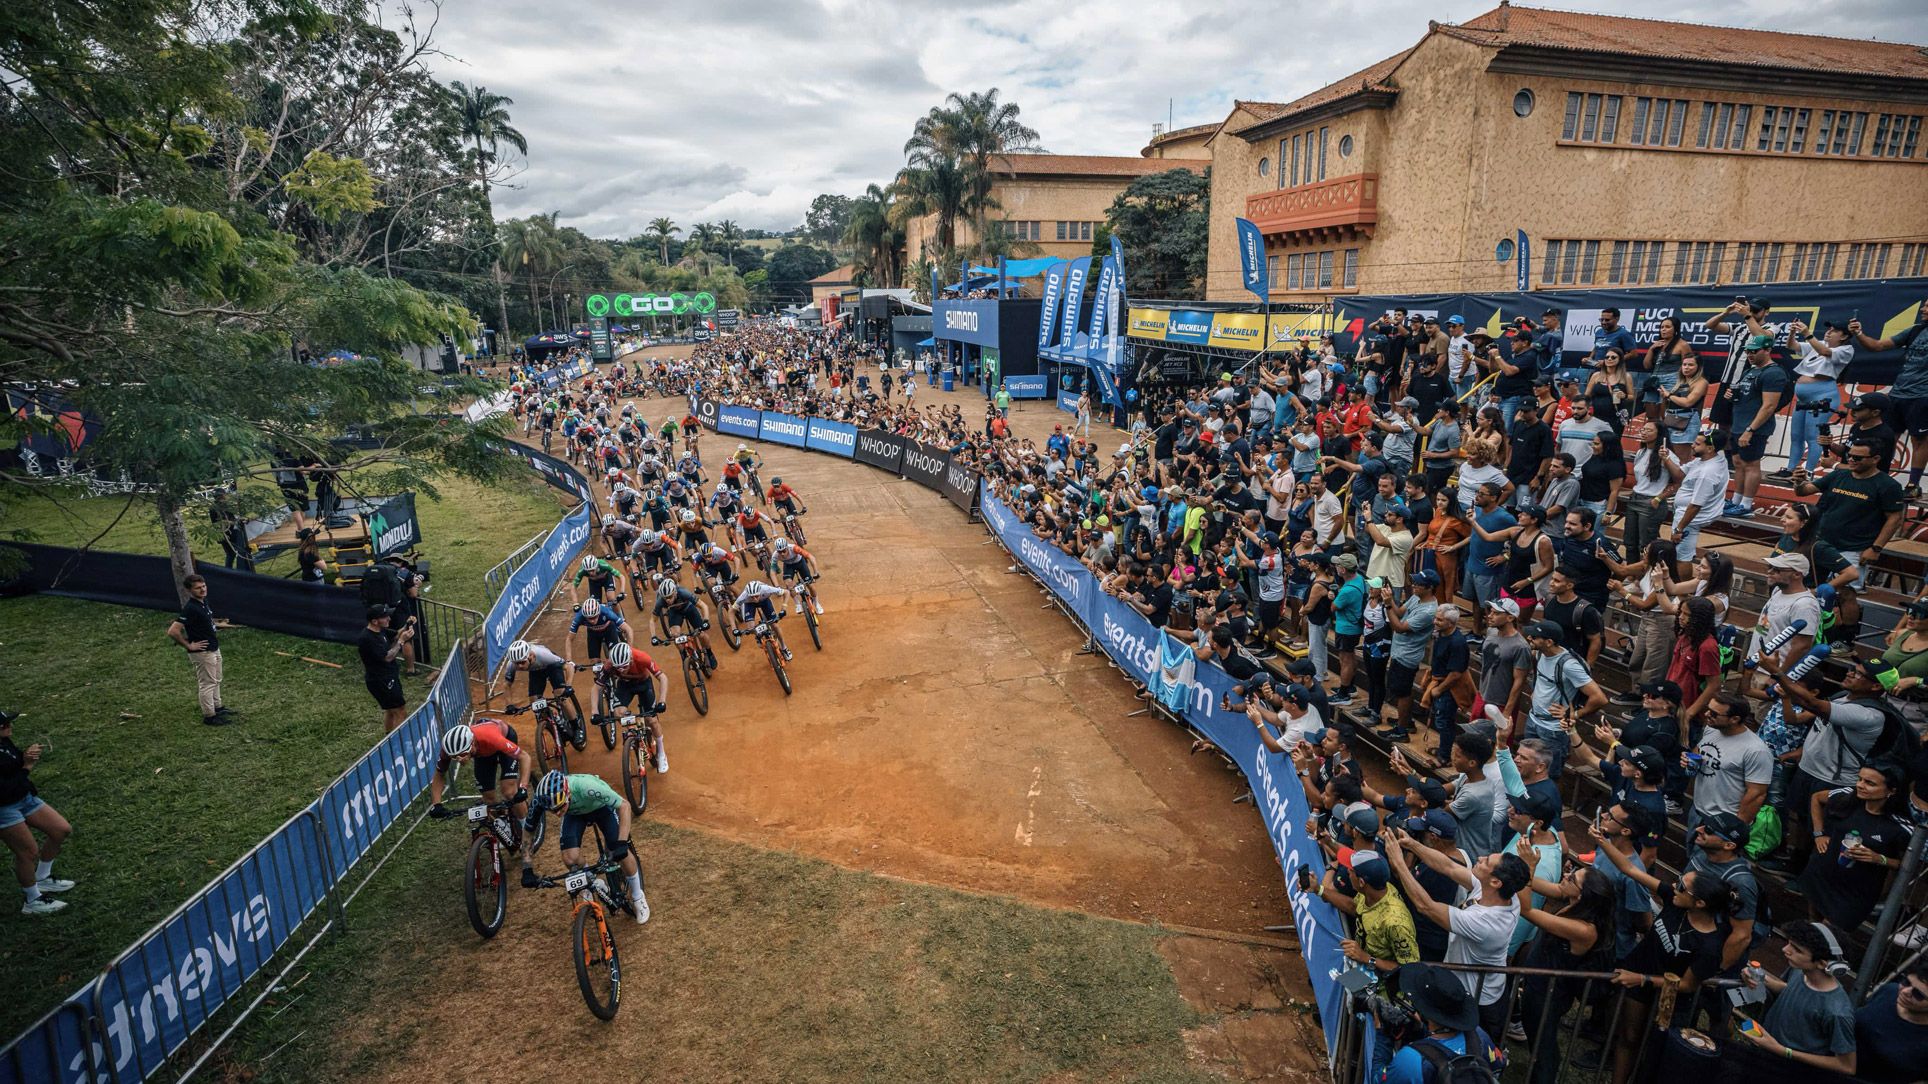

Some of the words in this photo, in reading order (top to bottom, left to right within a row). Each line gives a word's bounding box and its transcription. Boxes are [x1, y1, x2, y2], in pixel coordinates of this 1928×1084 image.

[1247, 232, 1256, 271] MICHELIN
[631, 297, 674, 311] GO
[1040, 273, 1059, 345] SHIMANO
[1063, 269, 1083, 347] SHIMANO
[1645, 308, 1674, 320] UCI
[946, 310, 978, 332] SHIMANO
[1140, 320, 1165, 329] MICHELIN
[1177, 323, 1208, 333] MICHELIN
[1223, 327, 1259, 337] MICHELIN
[720, 414, 758, 428] events.com
[763, 419, 804, 436] SHIMANO
[810, 426, 854, 446] SHIMANO
[860, 436, 900, 459] WHOOP
[906, 449, 945, 475] WHOOP
[947, 466, 976, 495] WHOOP
[550, 520, 590, 570] events.com
[1021, 537, 1079, 598] events.com
[495, 575, 540, 647] events.com
[474, 810, 481, 818] 8
[570, 878, 583, 889] 69
